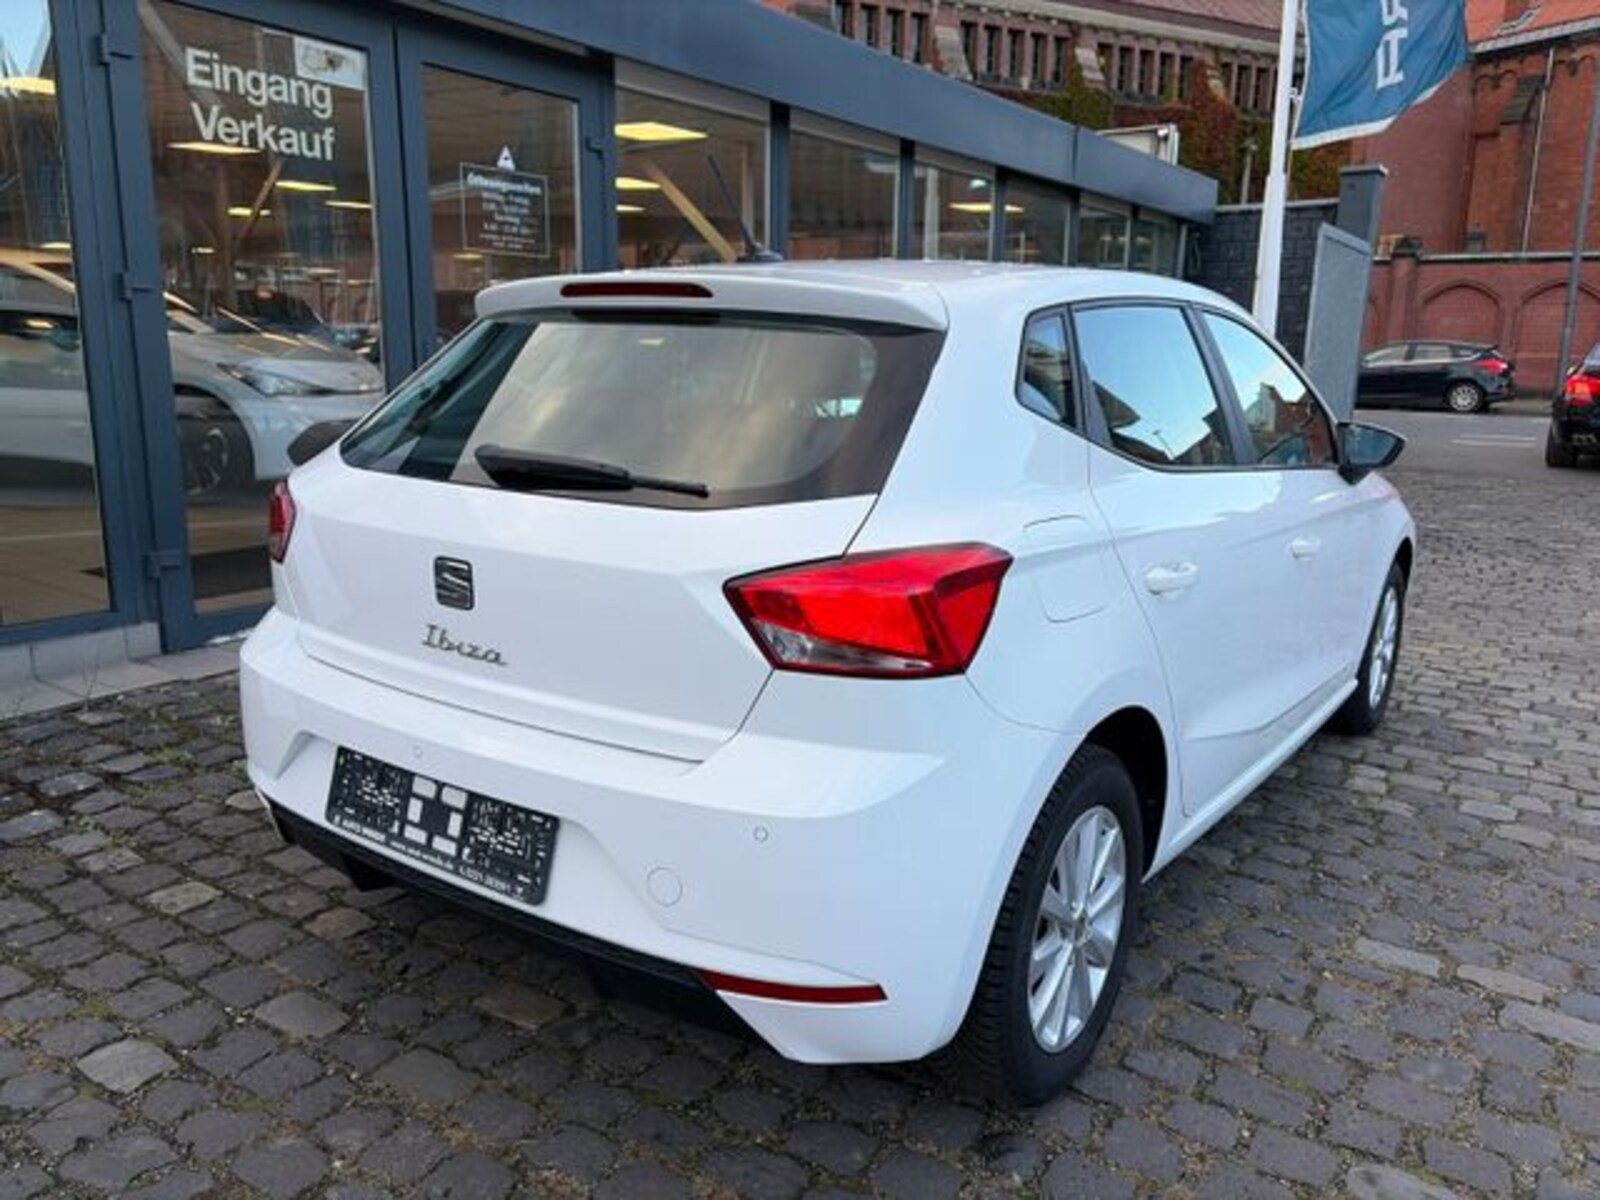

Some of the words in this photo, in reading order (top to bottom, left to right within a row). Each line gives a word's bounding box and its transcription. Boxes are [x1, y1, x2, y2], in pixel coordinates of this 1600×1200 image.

[185, 47, 332, 119] Eingang
[190, 101, 335, 161] Verkauf
[421, 623, 508, 666] Ibiza
